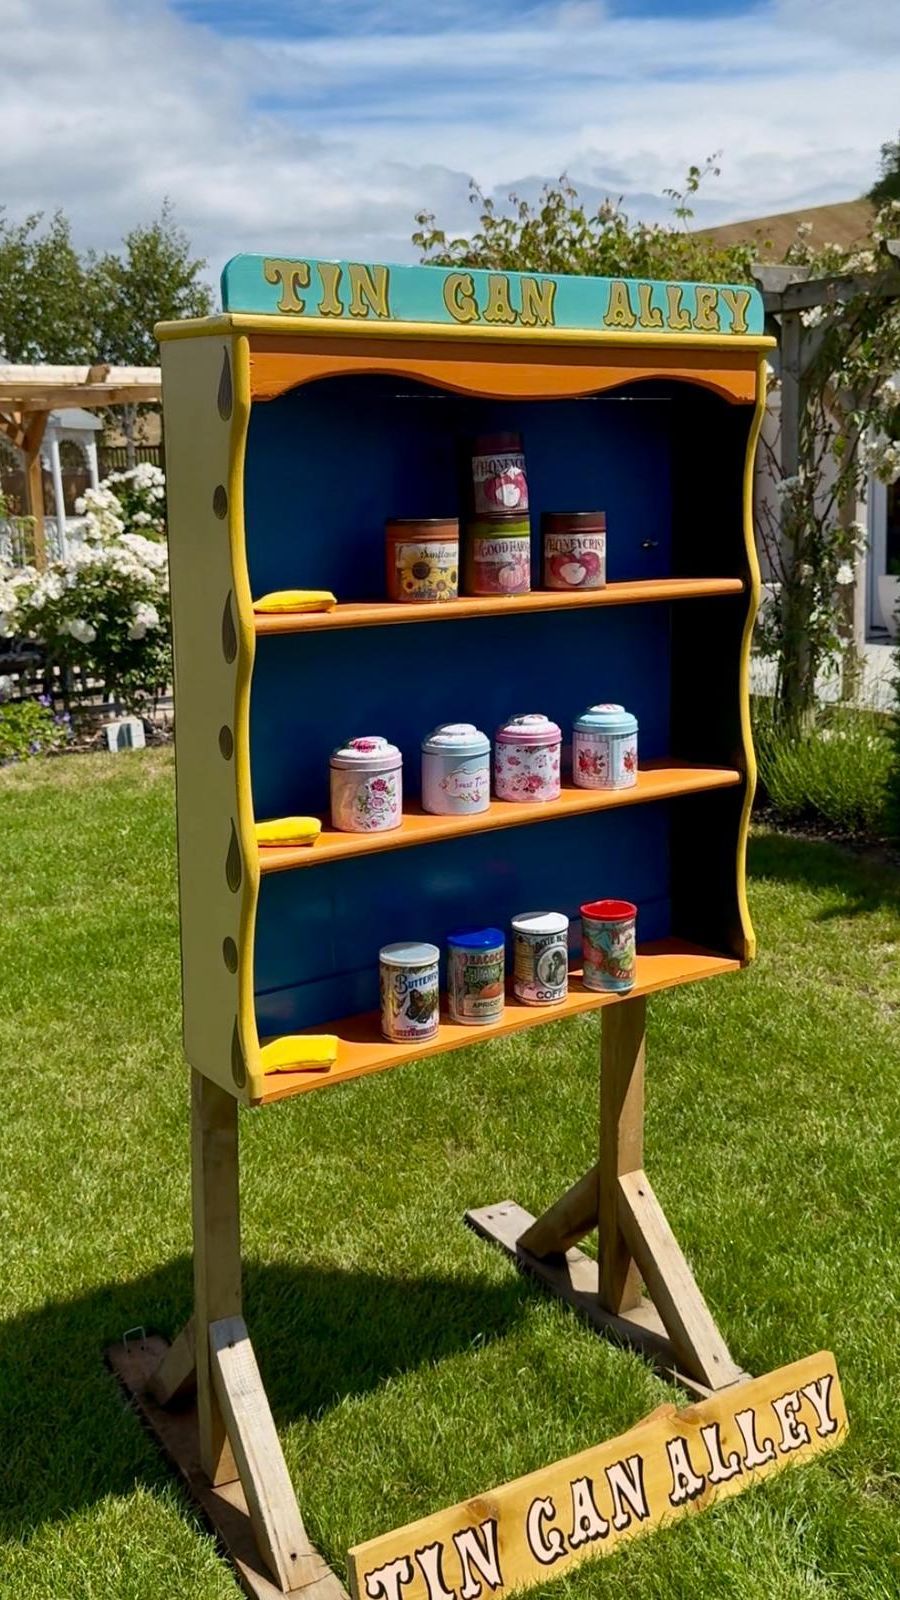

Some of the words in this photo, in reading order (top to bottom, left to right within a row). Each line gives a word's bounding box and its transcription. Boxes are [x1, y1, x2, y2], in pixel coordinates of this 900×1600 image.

[264, 258, 389, 317] TIN
[442, 273, 557, 325] CAN
[603, 280, 751, 333] ALLEY
[365, 1518, 504, 1600] TIN
[527, 1455, 649, 1565] CAN
[666, 1374, 839, 1507] ALLEY
